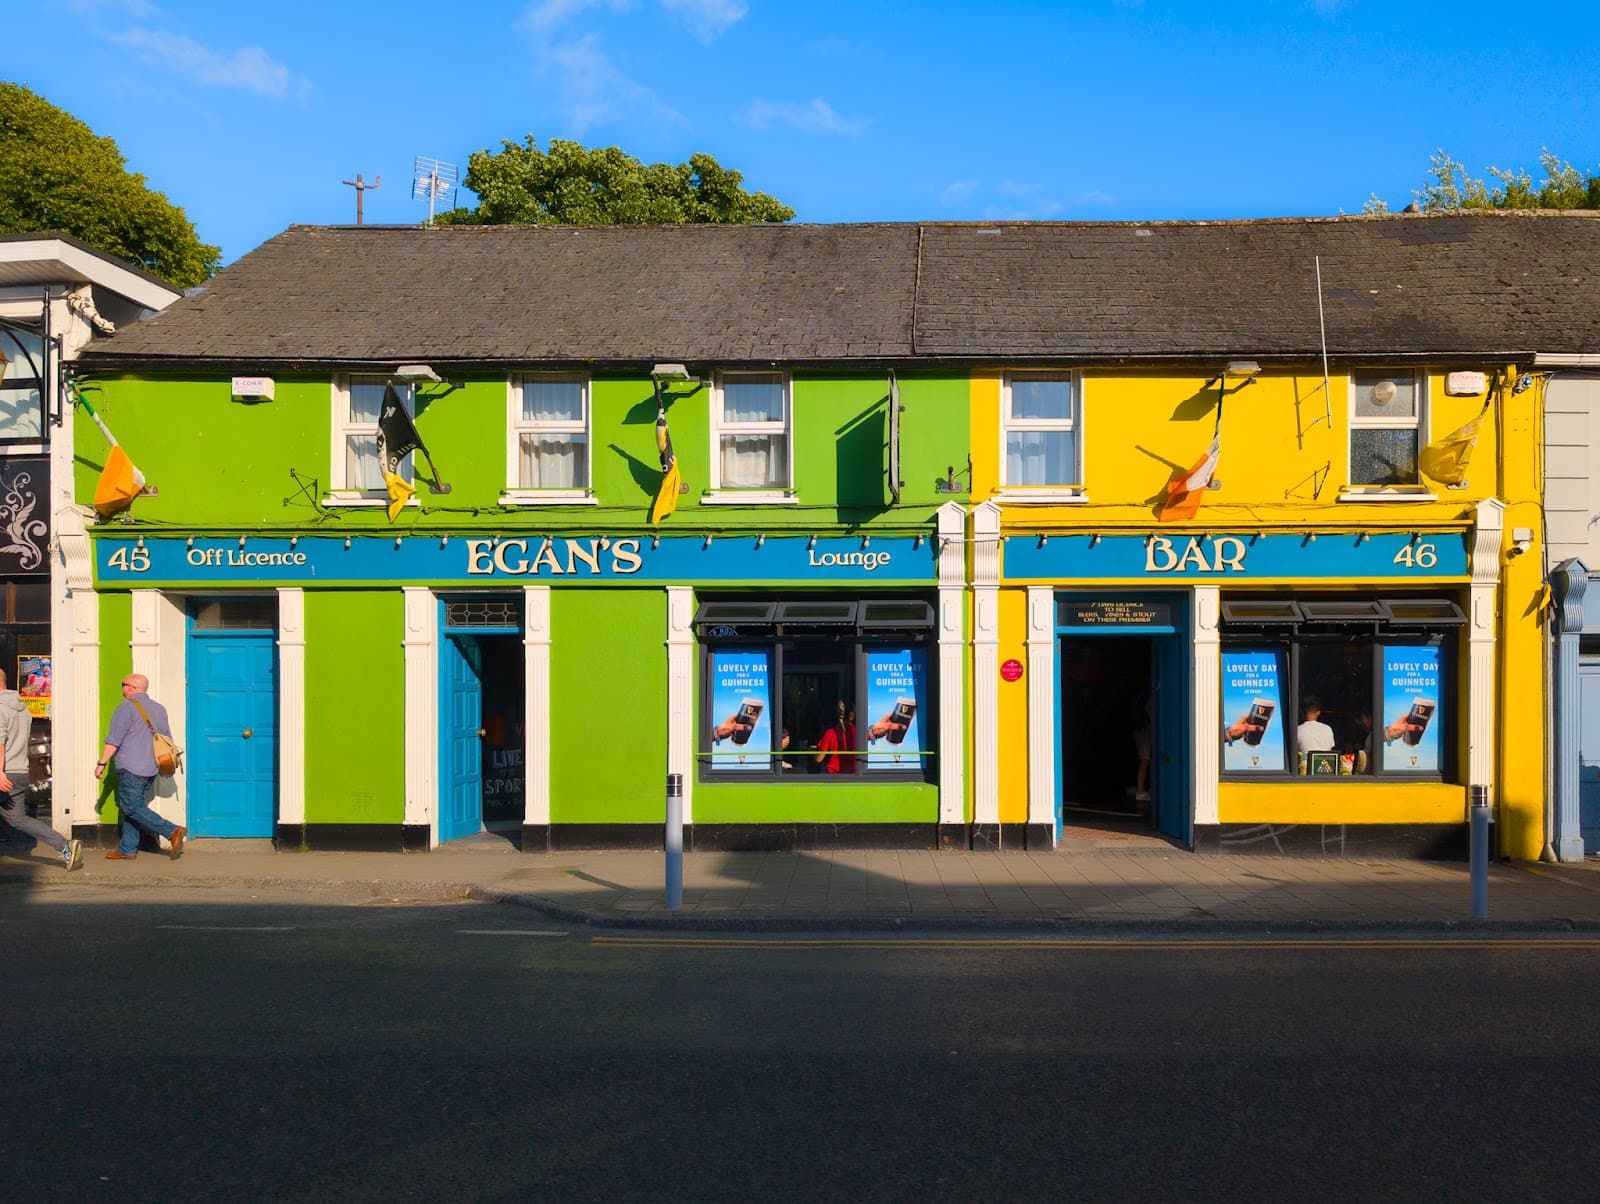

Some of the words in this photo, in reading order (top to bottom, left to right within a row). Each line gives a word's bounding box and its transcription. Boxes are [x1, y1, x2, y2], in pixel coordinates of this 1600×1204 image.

[186, 548, 224, 566] Off
[228, 549, 306, 566] Licence
[466, 539, 643, 575] EGAN'S
[1144, 536, 1247, 572] BAR
[1393, 544, 1438, 568] 46
[107, 547, 151, 571] 45
[808, 549, 891, 571] Lounge
[718, 664, 749, 673] LOVELY
[752, 664, 768, 672] DAY
[872, 663, 904, 672] LOVELY
[1226, 664, 1259, 673] LOVELY
[1261, 664, 1277, 672] DAY
[1388, 663, 1420, 671] LOVELY
[1423, 663, 1440, 671] DAY
[721, 678, 765, 687] GUINNESS
[1231, 679, 1275, 687] GUINNESS
[1392, 678, 1436, 686] GUINNESS
